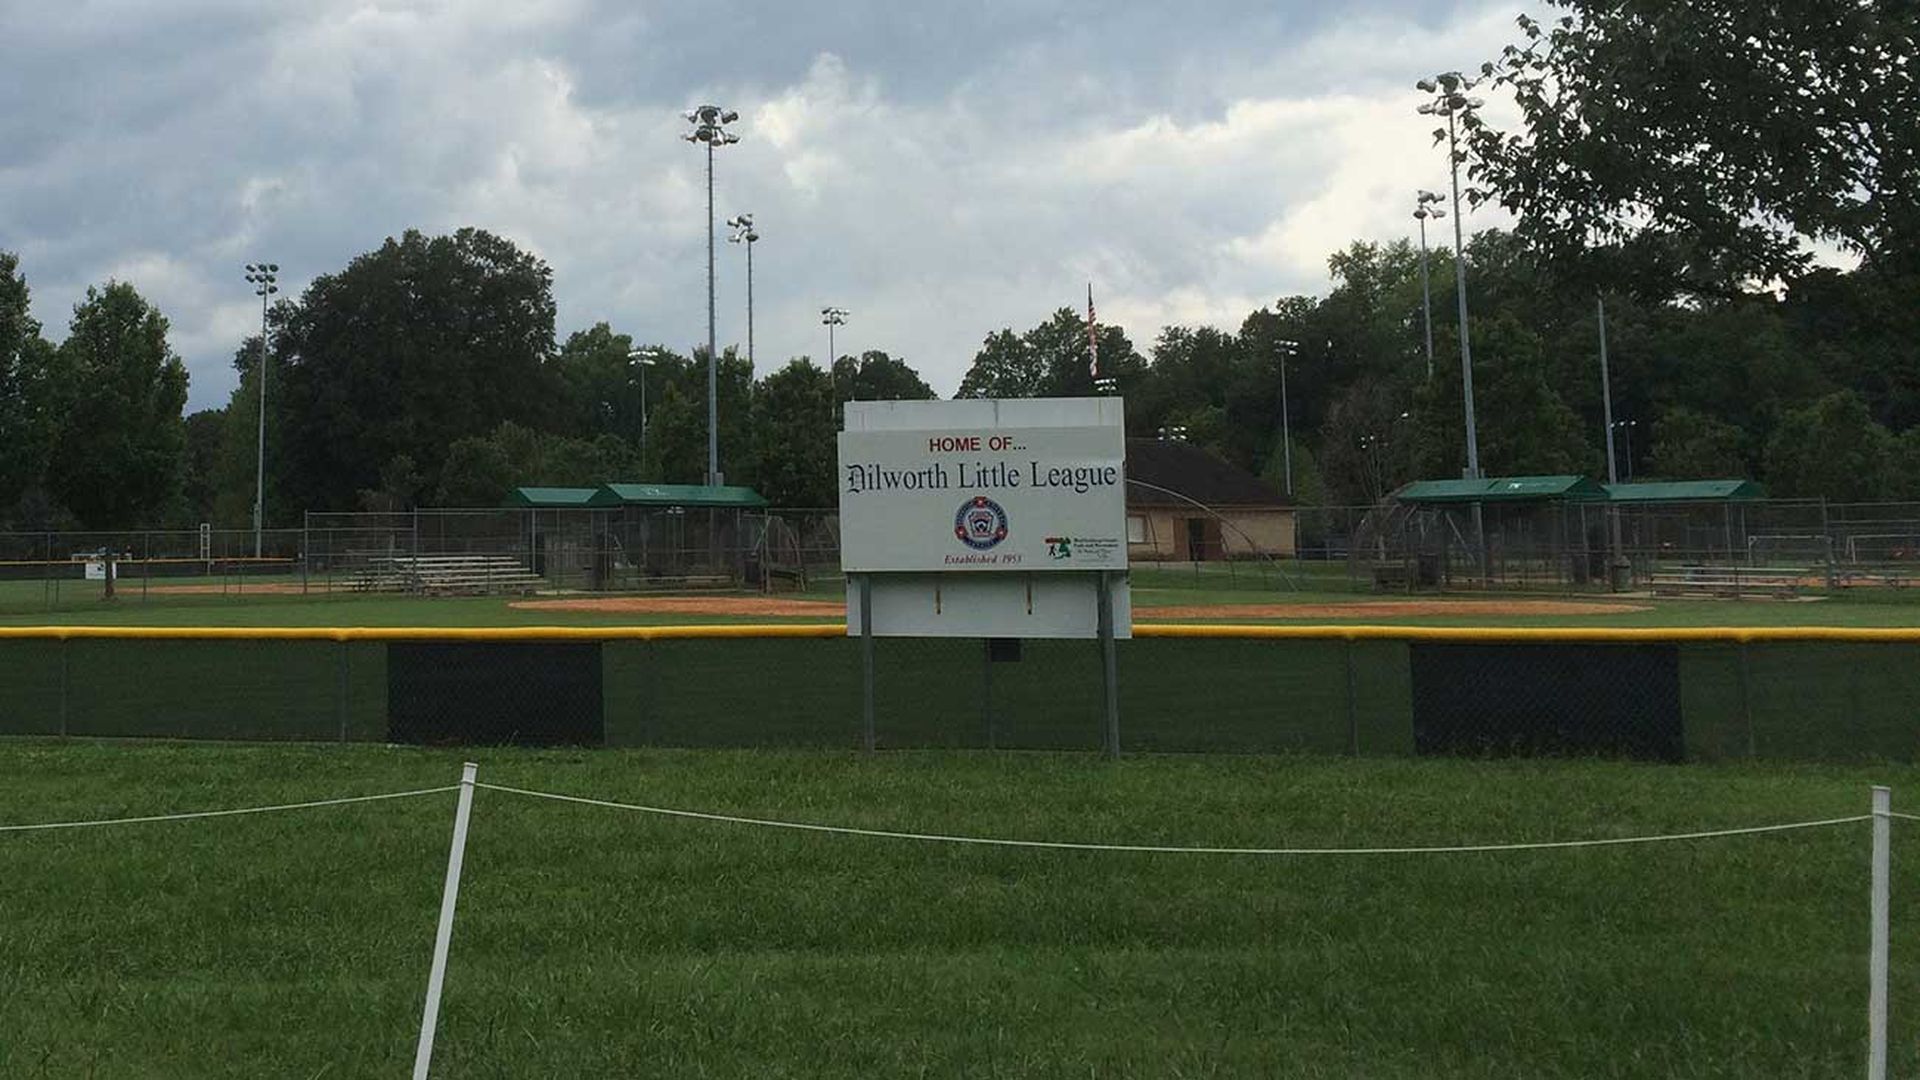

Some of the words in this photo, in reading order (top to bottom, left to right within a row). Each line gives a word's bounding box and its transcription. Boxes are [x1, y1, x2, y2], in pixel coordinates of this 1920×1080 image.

[929, 437, 981, 452] HOME
[989, 436, 1026, 451] OF...
[847, 463, 948, 494] Dilworth
[957, 461, 1020, 489] Little
[1031, 461, 1117, 494] League
